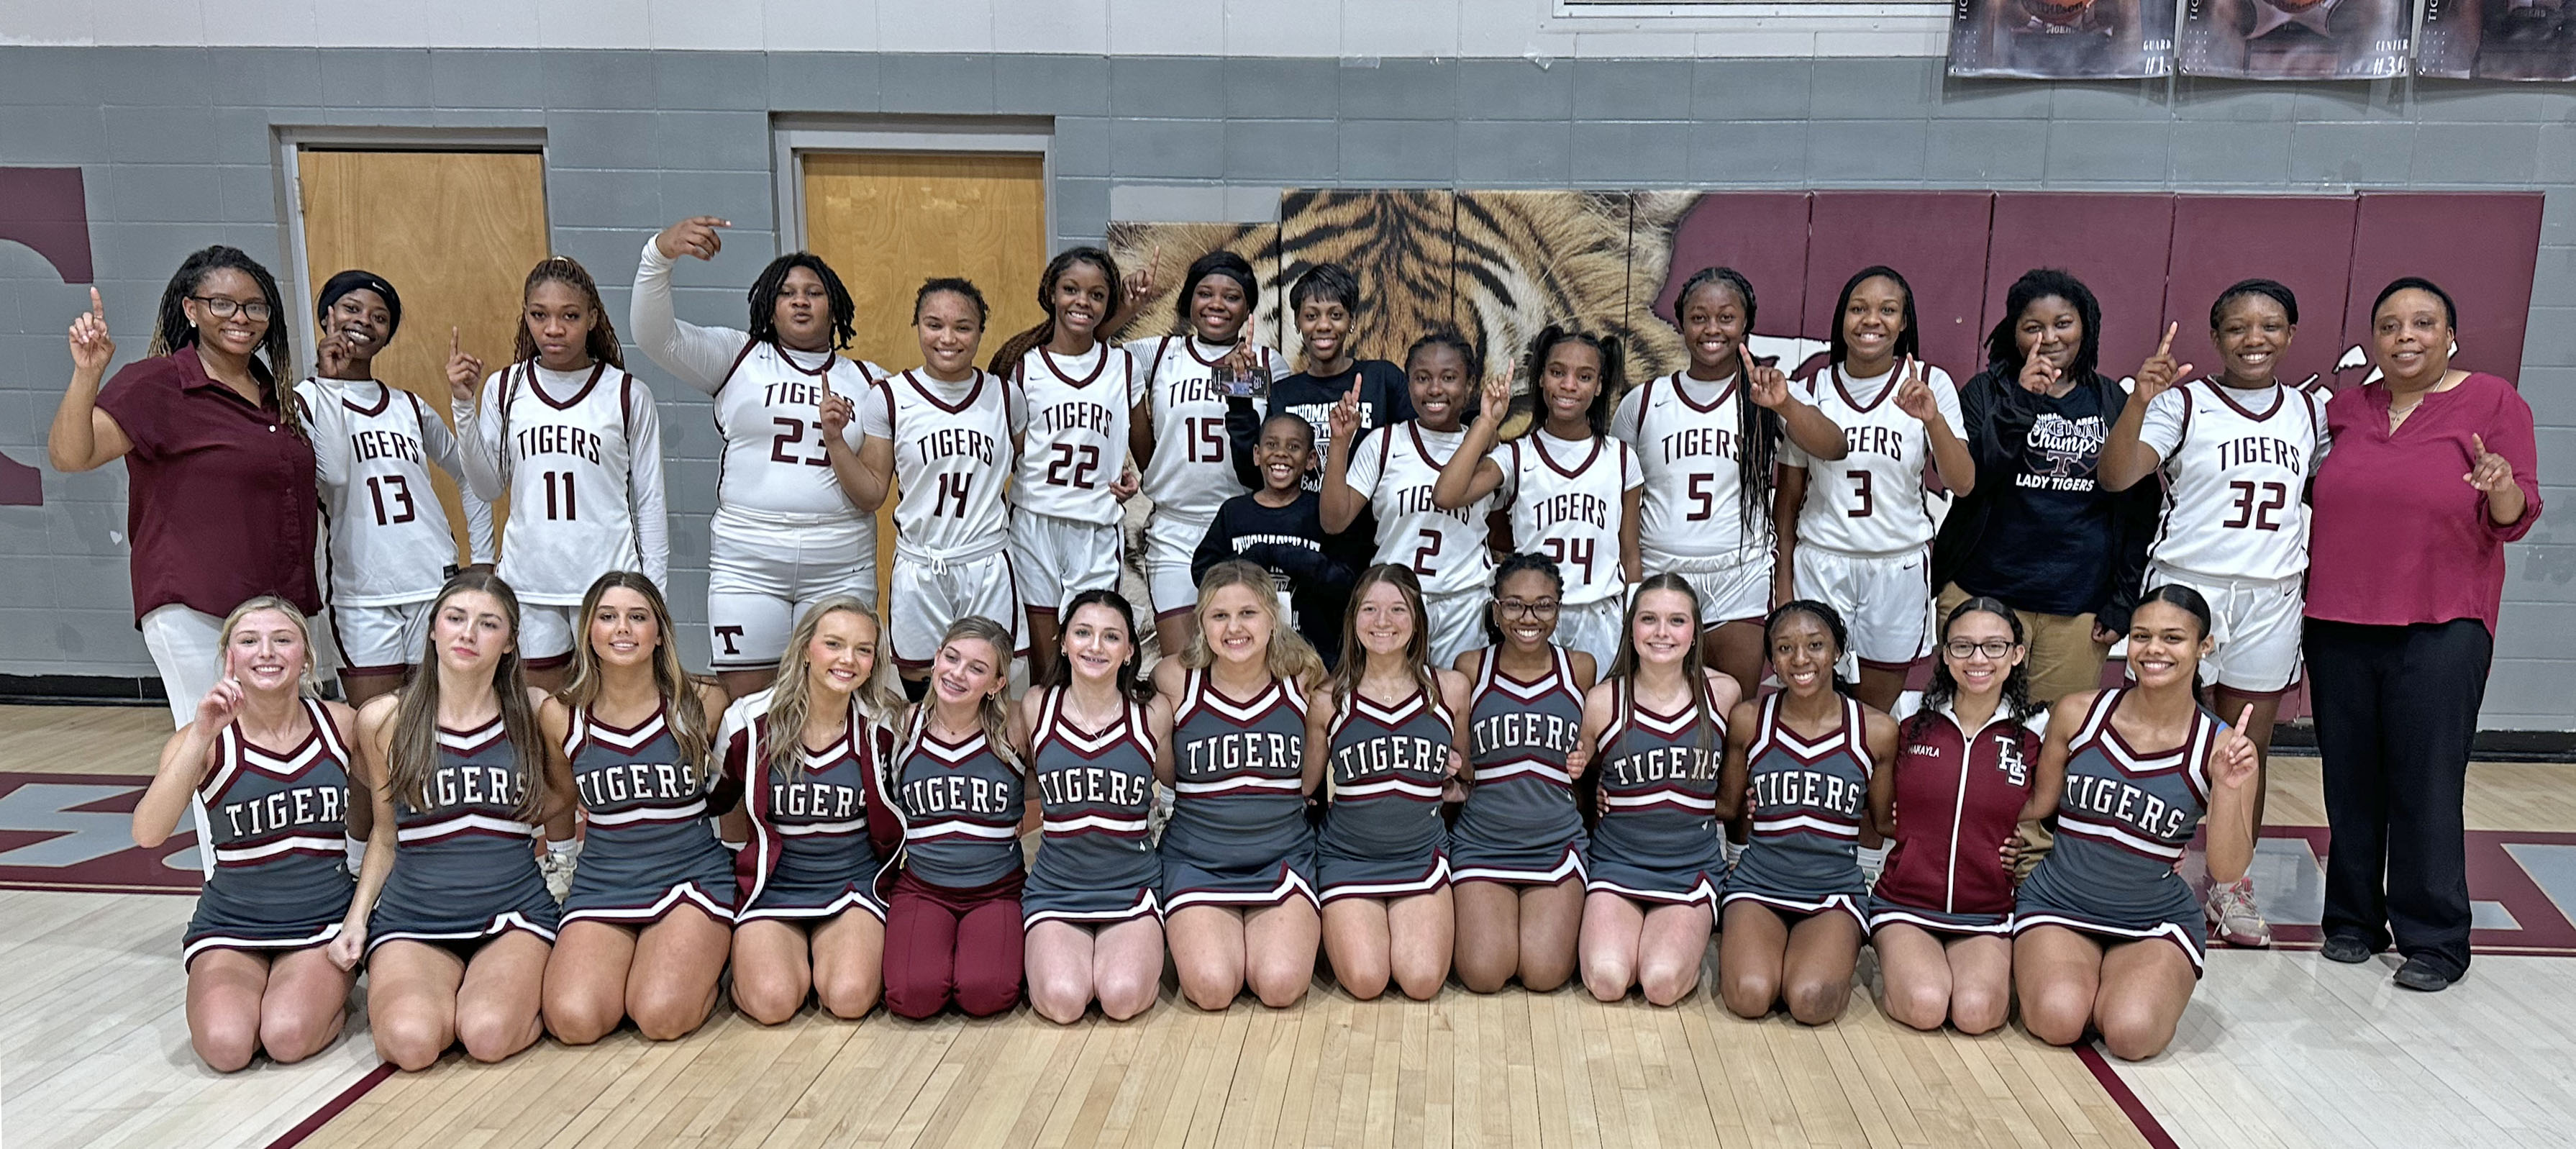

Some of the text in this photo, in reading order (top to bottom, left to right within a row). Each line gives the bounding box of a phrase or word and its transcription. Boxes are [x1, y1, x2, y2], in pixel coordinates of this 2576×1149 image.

[2143, 39, 2171, 50] GUARD
[1042, 401, 1113, 439] TIGERS
[1185, 417, 1224, 463] 15
[516, 424, 601, 466] TIGERS
[917, 428, 995, 466] TIGERS
[2027, 426, 2097, 459] Champs
[2217, 436, 2300, 476] TIGERS
[1047, 443, 1100, 489] 22
[2016, 473, 2095, 491] LADY TIGERS
[366, 475, 415, 526] 13
[543, 471, 576, 520] 11
[934, 473, 973, 519] 14
[1533, 493, 1607, 531] TIGERS
[1687, 473, 1714, 522] 5
[1847, 470, 1872, 518] 3
[2223, 481, 2287, 532] 32
[1414, 529, 1442, 577] 2
[714, 625, 744, 655] T
[1187, 732, 1301, 774] TIGERS
[1474, 713, 1579, 755] TIGERS
[1339, 736, 1447, 779] TIGERS
[902, 776, 1009, 816] TIGERS
[1038, 768, 1145, 805] TIGERS
[1754, 771, 1860, 815] TIGERS
[2067, 774, 2185, 839] TIGERS
